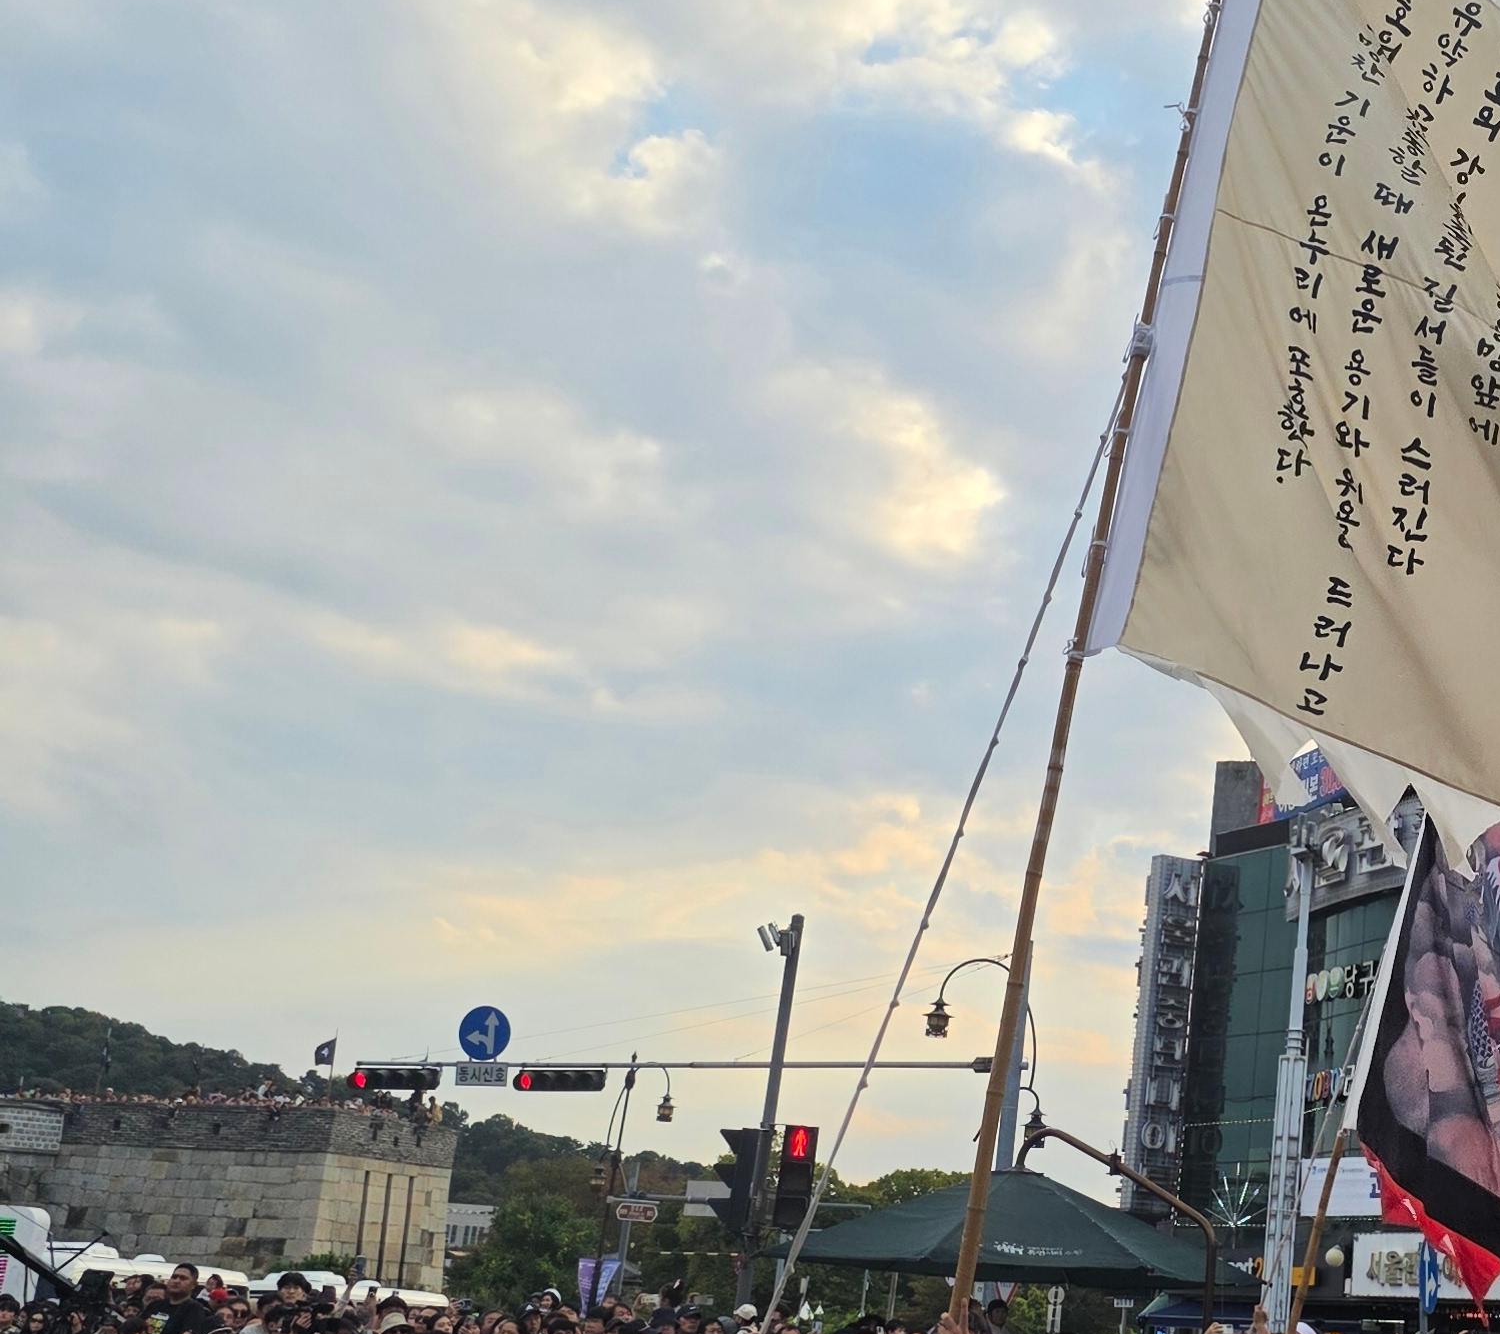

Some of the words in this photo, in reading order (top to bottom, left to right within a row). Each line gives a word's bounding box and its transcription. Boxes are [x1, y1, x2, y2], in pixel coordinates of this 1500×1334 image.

[1319, 90, 1371, 177] 기운이
[1289, 195, 1333, 335] 온누리에
[1352, 230, 1400, 334] 새로운
[1411, 276, 1458, 419] 질서들이
[1335, 349, 1371, 457] 용기와
[1296, 576, 1353, 716] 드러나고
[458, 1067, 505, 1083] 동시신호
